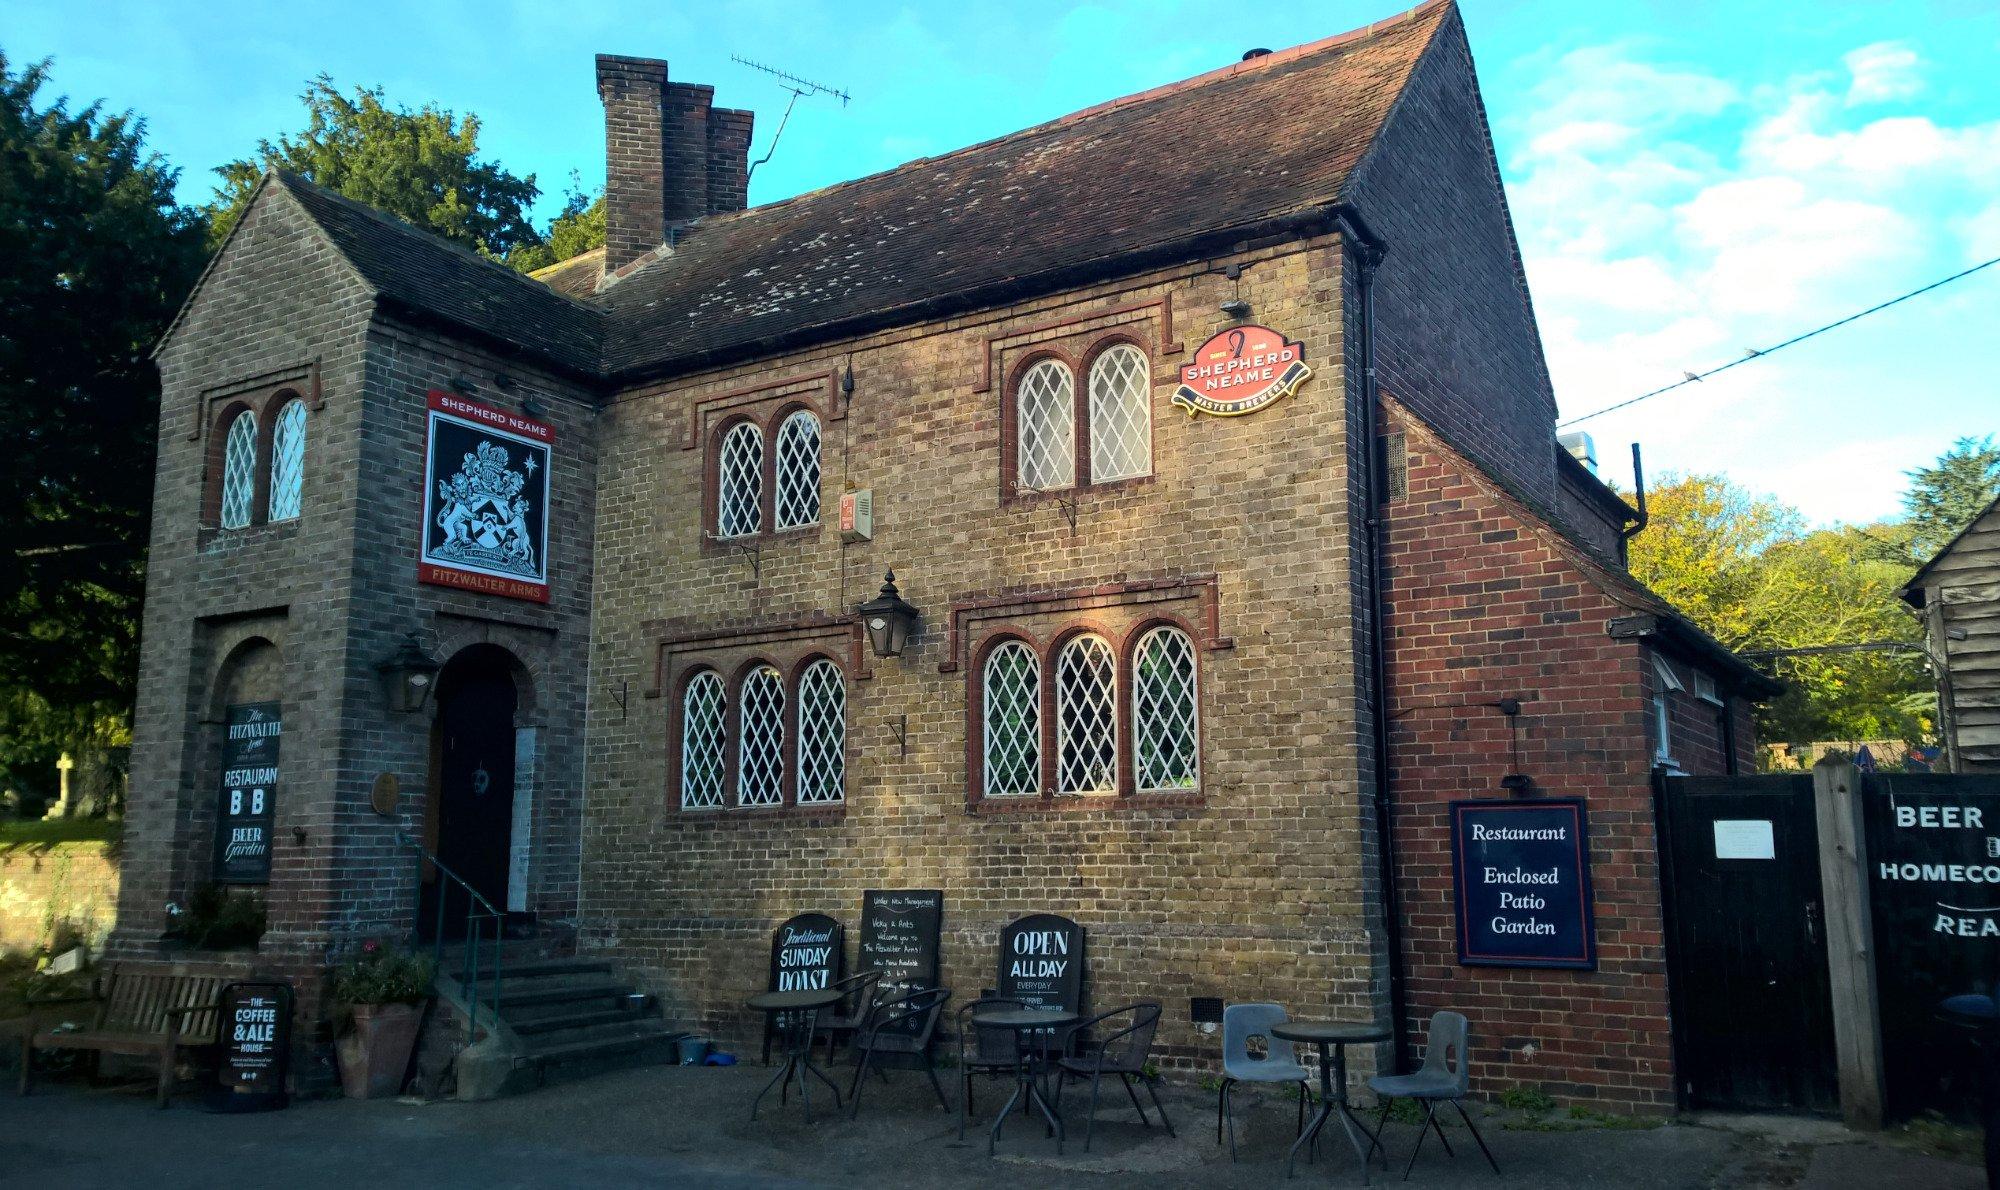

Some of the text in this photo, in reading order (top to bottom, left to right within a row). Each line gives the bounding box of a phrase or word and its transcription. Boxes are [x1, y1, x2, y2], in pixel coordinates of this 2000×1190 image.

[1187, 349, 1293, 380] SHEPHERD
[1206, 368, 1275, 391] NEAME
[1194, 380, 1286, 411] MASTER BREWERS
[441, 397, 547, 437] SHEPHERD NEAME
[432, 569, 541, 597] FITZWALTER ARMS
[225, 768, 278, 786] RESTAURAN
[1896, 806, 1984, 829] BEER
[233, 827, 262, 842] BEER
[1472, 823, 1566, 841] Restaurant
[225, 842, 266, 862] Garden
[1484, 866, 1559, 885] Enclosed
[1880, 862, 2000, 884] HOMECO
[873, 896, 888, 905] Under
[1500, 892, 1546, 910] Patio
[1491, 916, 1557, 935] Garden
[1933, 913, 2000, 938] REA
[782, 926, 833, 947] Traditional
[900, 936, 909, 945] you
[1013, 931, 1069, 955] OPEN
[780, 946, 832, 968] SUNDAY
[1017, 981, 1053, 990] EVERYDAY
[250, 997, 264, 1007] THE
[235, 1009, 276, 1023] COFFEE
[240, 1043, 264, 1053] HOUSE
